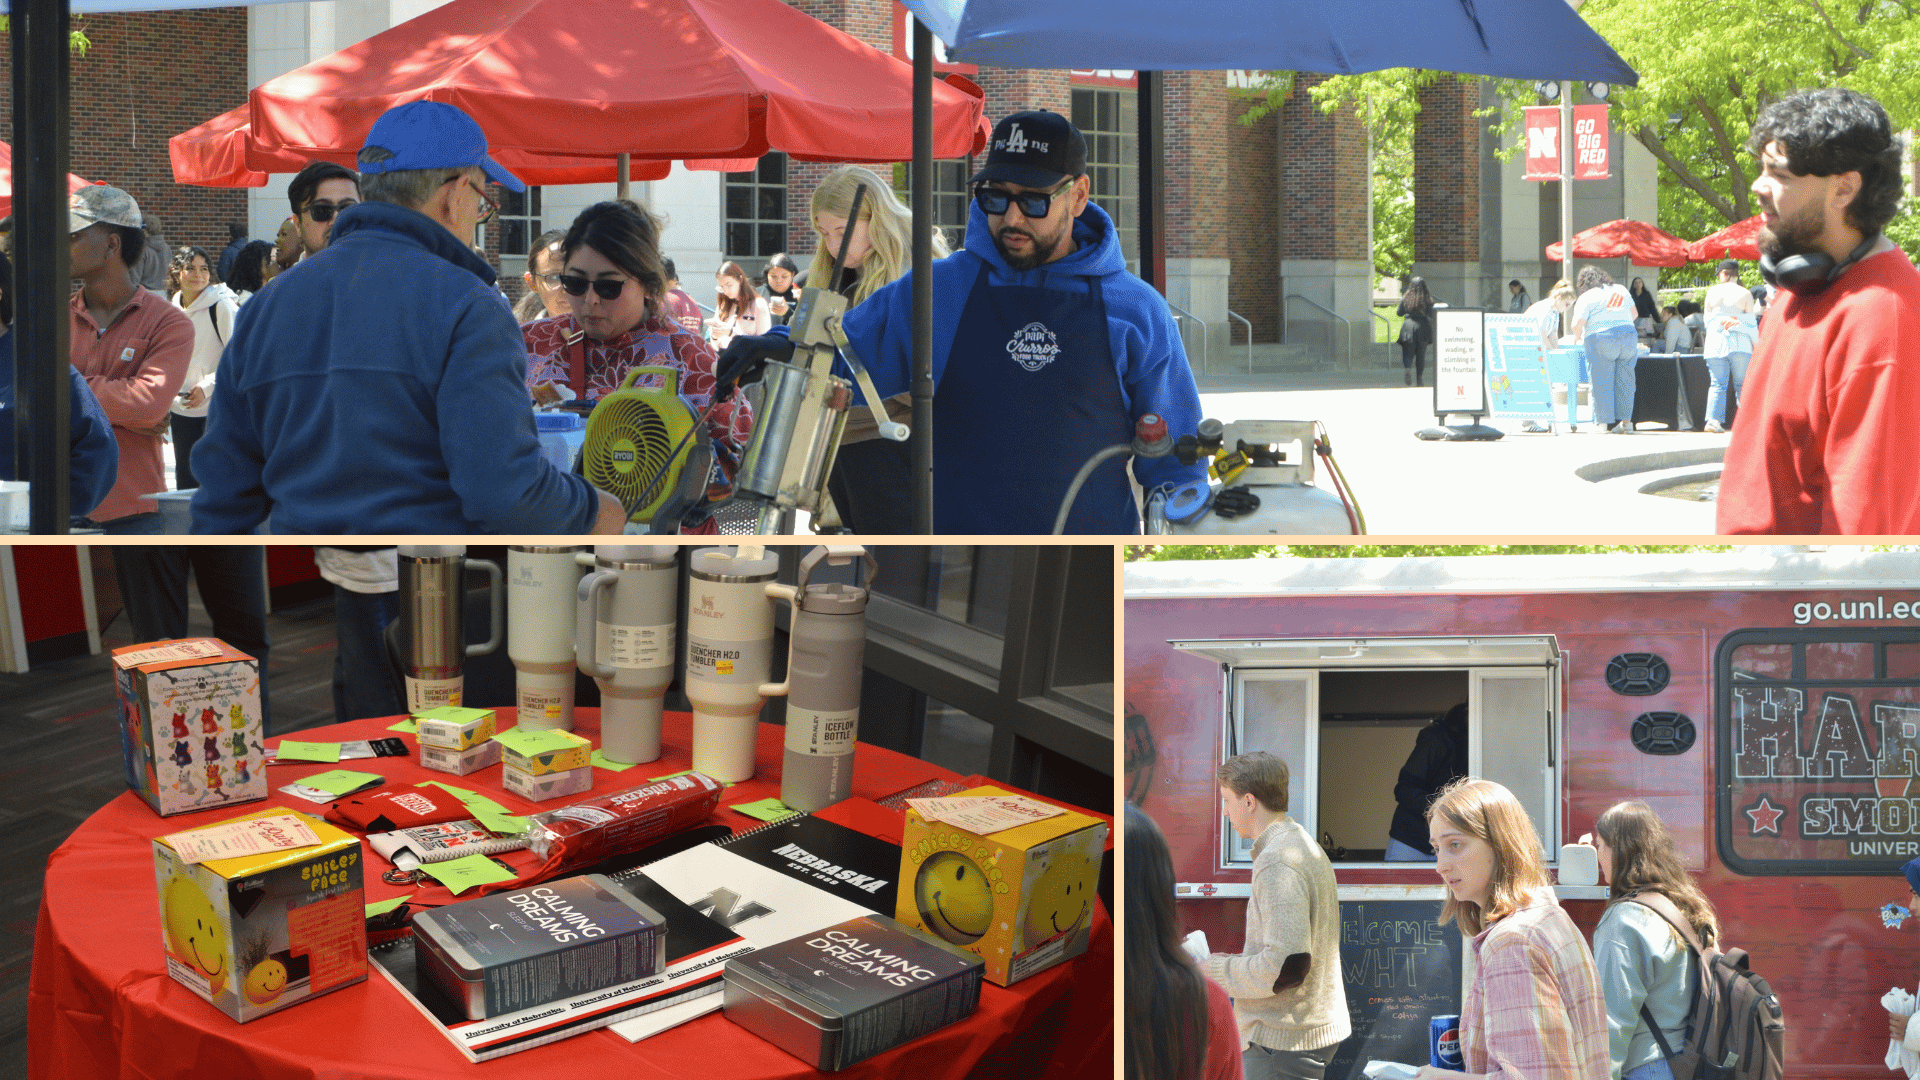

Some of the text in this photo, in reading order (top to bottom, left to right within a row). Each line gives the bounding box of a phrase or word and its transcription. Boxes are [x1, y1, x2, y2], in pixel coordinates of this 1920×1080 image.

[1576, 119, 1595, 134] GO
[1006, 122, 1028, 153] LA
[1578, 133, 1601, 149] BIG
[1579, 148, 1606, 164] RED
[1444, 356, 1469, 364] climbing
[614, 451, 633, 460] RYOBI
[811, 714, 819, 745] STANLEY
[825, 720, 855, 731] ICEFLOW
[1734, 671, 1920, 778] HAR
[824, 730, 850, 741] BOTTLE
[610, 782, 673, 807] HUSKERS
[1850, 841, 1919, 855] UNIVER
[771, 842, 889, 894] NEBRASKA
[311, 869, 348, 892] FACE
[506, 893, 579, 943] DREAMS
[531, 886, 606, 938] CALMING
[805, 937, 914, 987] DREAMS
[825, 930, 936, 981] CALMING
[667, 961, 709, 981] University
[569, 992, 614, 1009] University
[465, 1021, 511, 1039] University
